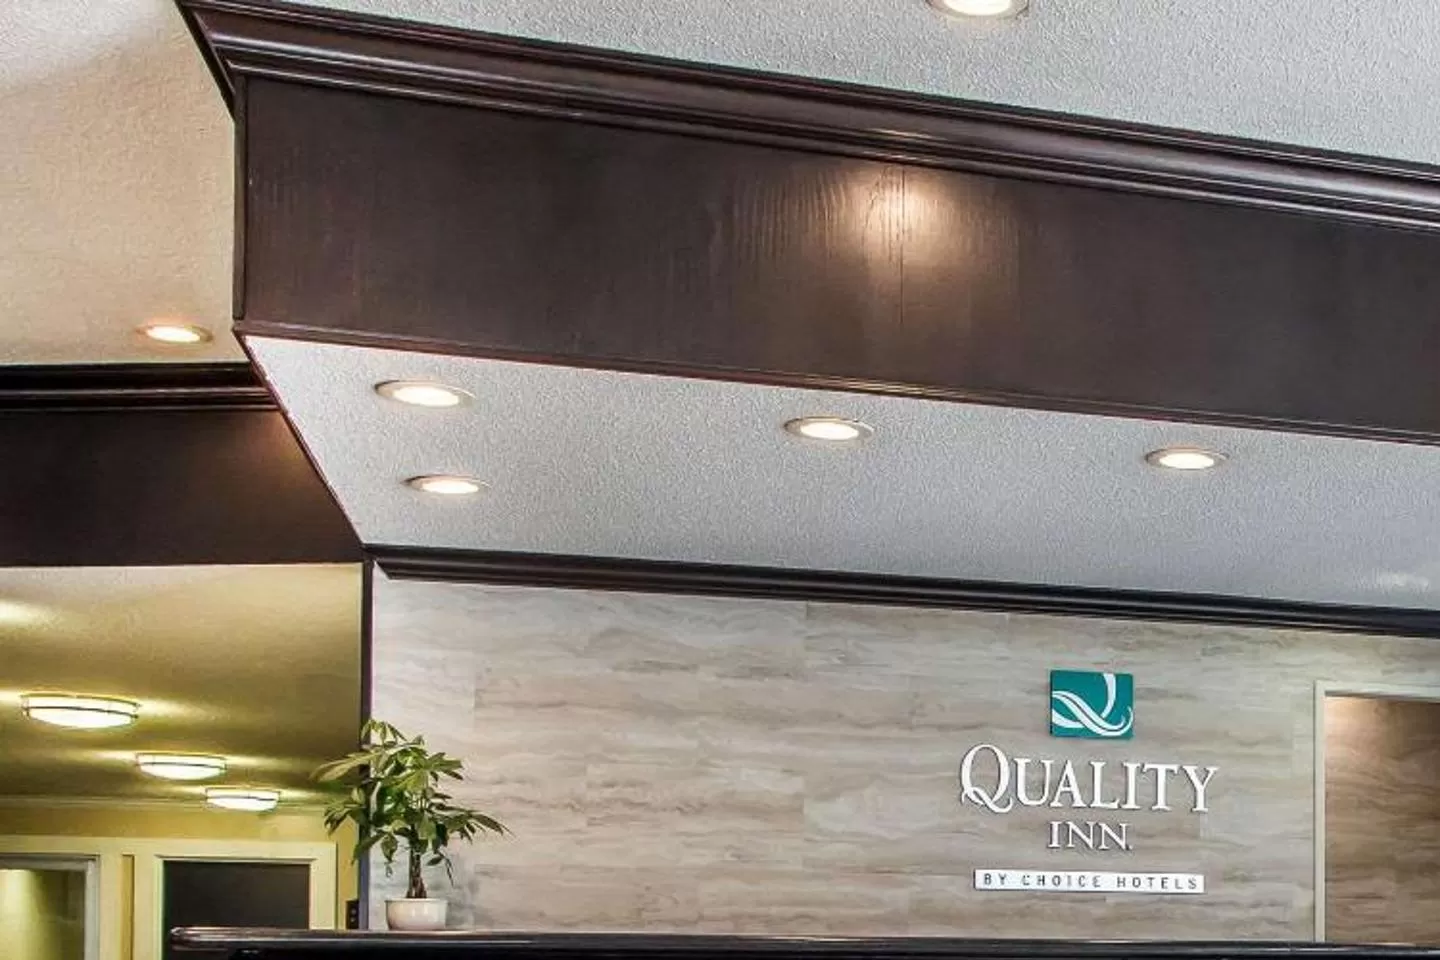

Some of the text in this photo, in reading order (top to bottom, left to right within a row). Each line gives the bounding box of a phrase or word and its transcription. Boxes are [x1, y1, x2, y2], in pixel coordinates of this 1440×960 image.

[960, 744, 1219, 813] QUALITY
[1047, 821, 1131, 850] INN
[984, 873, 1198, 890] BY CHOICE HOTELS
